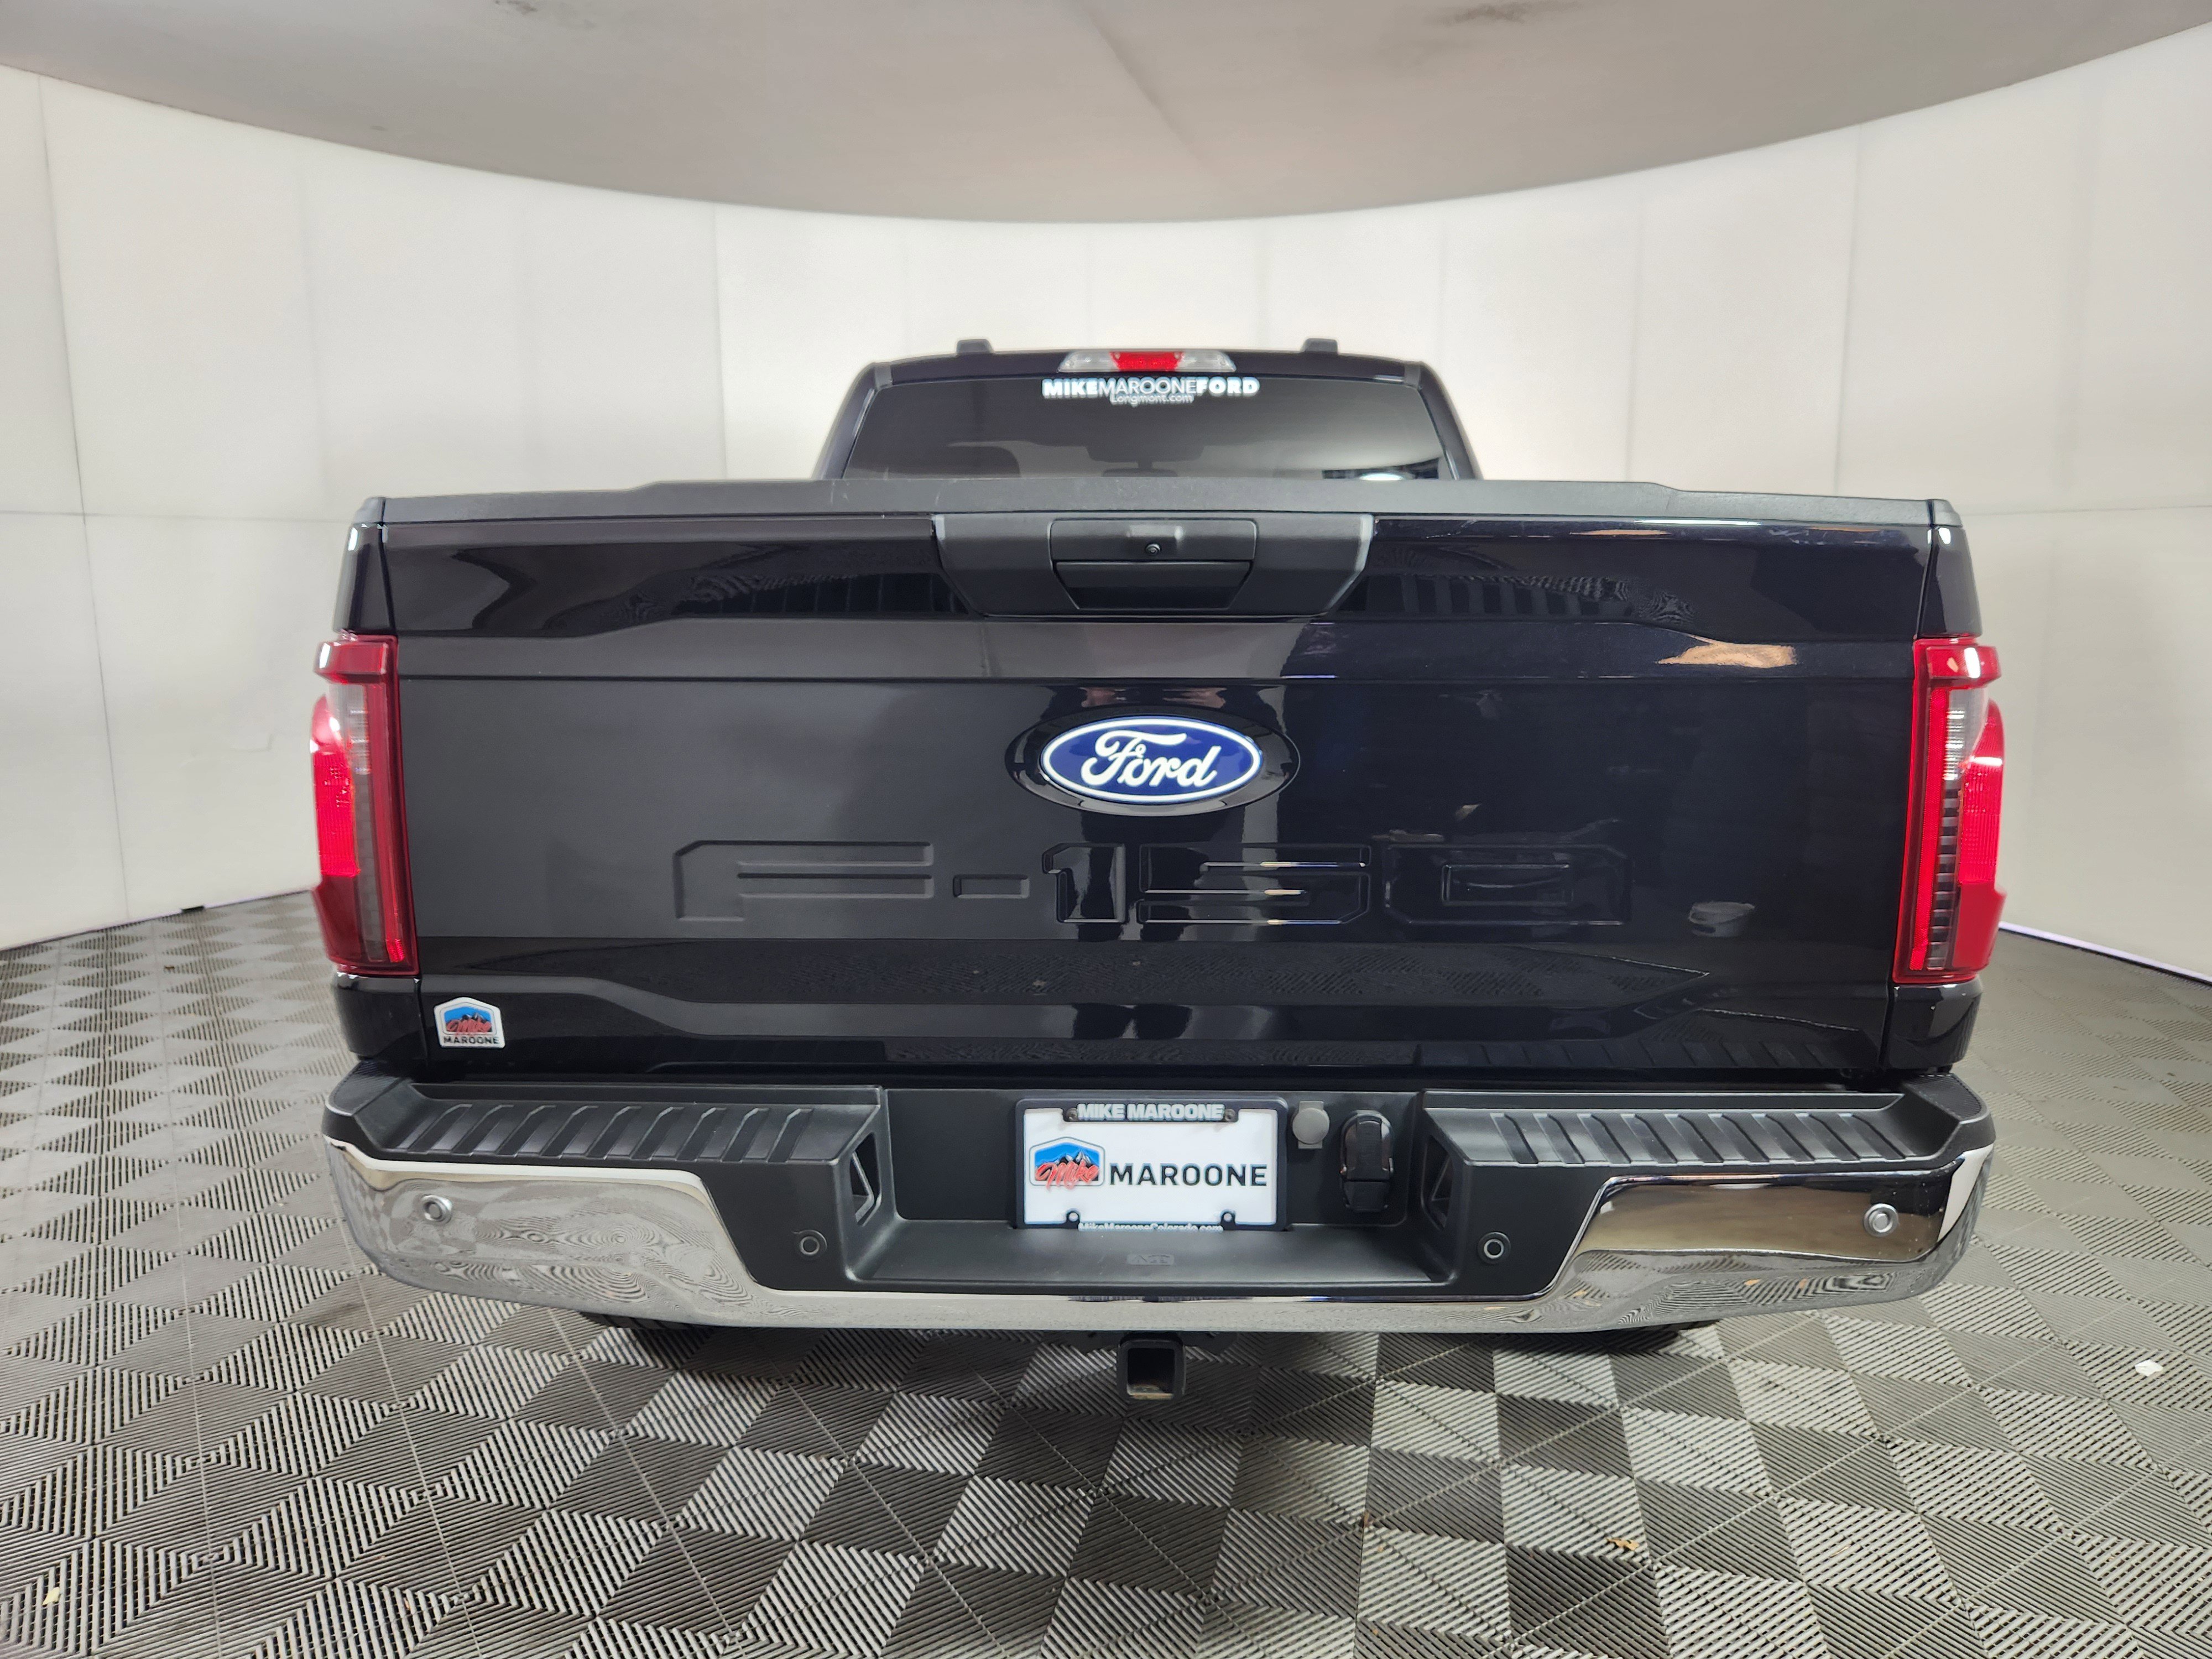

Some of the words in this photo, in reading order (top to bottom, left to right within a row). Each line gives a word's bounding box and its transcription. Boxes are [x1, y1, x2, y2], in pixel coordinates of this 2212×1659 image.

[1110, 394, 1194, 406] Longmont.com
[1081, 729, 1222, 787] Ford
[673, 841, 1632, 926] F-150
[443, 1036, 499, 1045] MAROONE
[1077, 1103, 1125, 1121] MIKE
[1126, 1103, 1225, 1121] MAROONE
[1035, 1159, 1099, 1190] Mike
[1109, 1162, 1267, 1187] MAROONE
